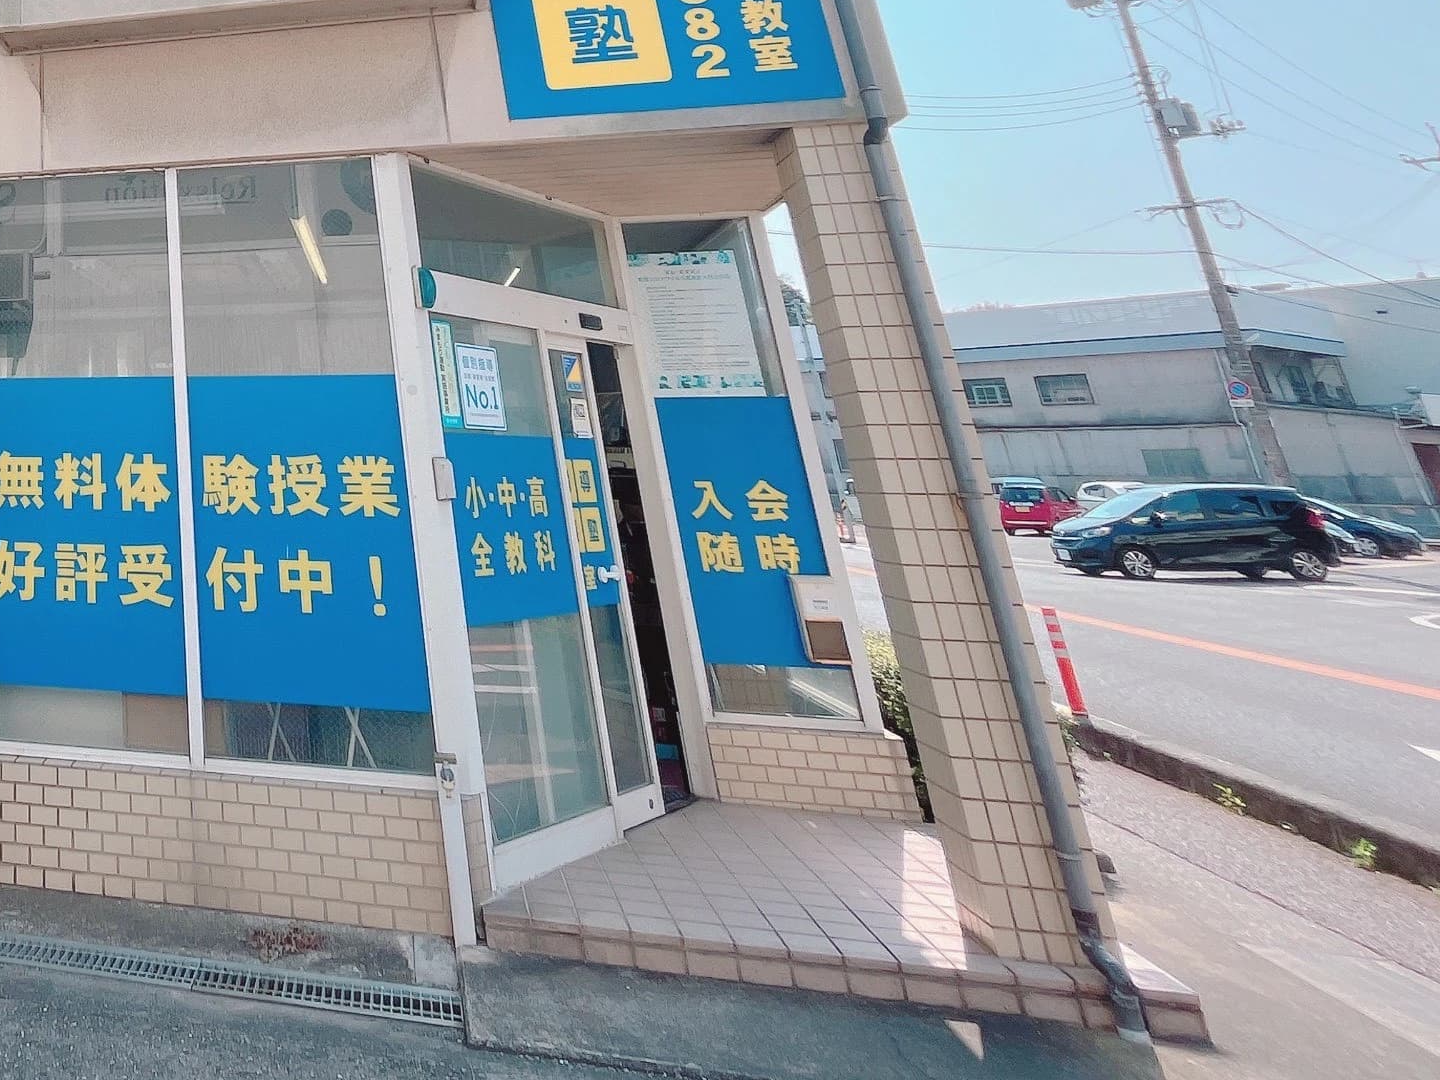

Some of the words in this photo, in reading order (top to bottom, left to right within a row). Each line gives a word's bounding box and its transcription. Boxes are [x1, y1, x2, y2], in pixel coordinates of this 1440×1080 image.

[692, 479, 789, 523] 入会
[470, 529, 556, 578] 全教科
[696, 531, 801, 575] 随時
